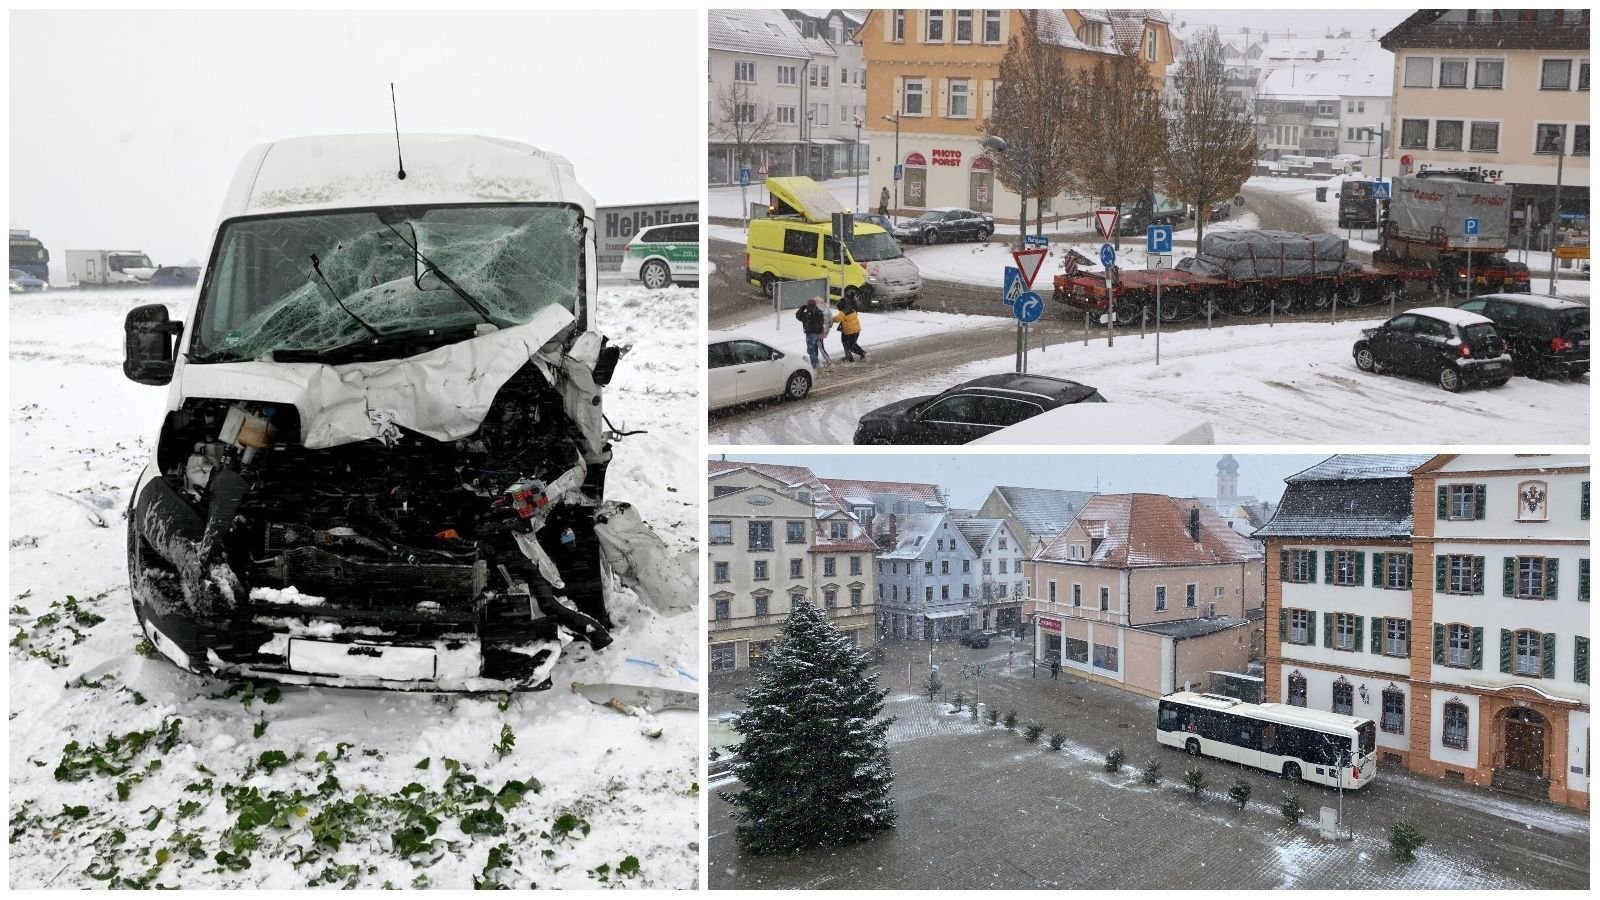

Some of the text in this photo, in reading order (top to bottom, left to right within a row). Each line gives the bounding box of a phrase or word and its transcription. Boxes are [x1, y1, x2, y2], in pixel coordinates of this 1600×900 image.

[932, 149, 961, 158] PHOTO
[932, 157, 961, 167] PORST
[1467, 220, 1475, 232] P
[1153, 229, 1167, 250] P
